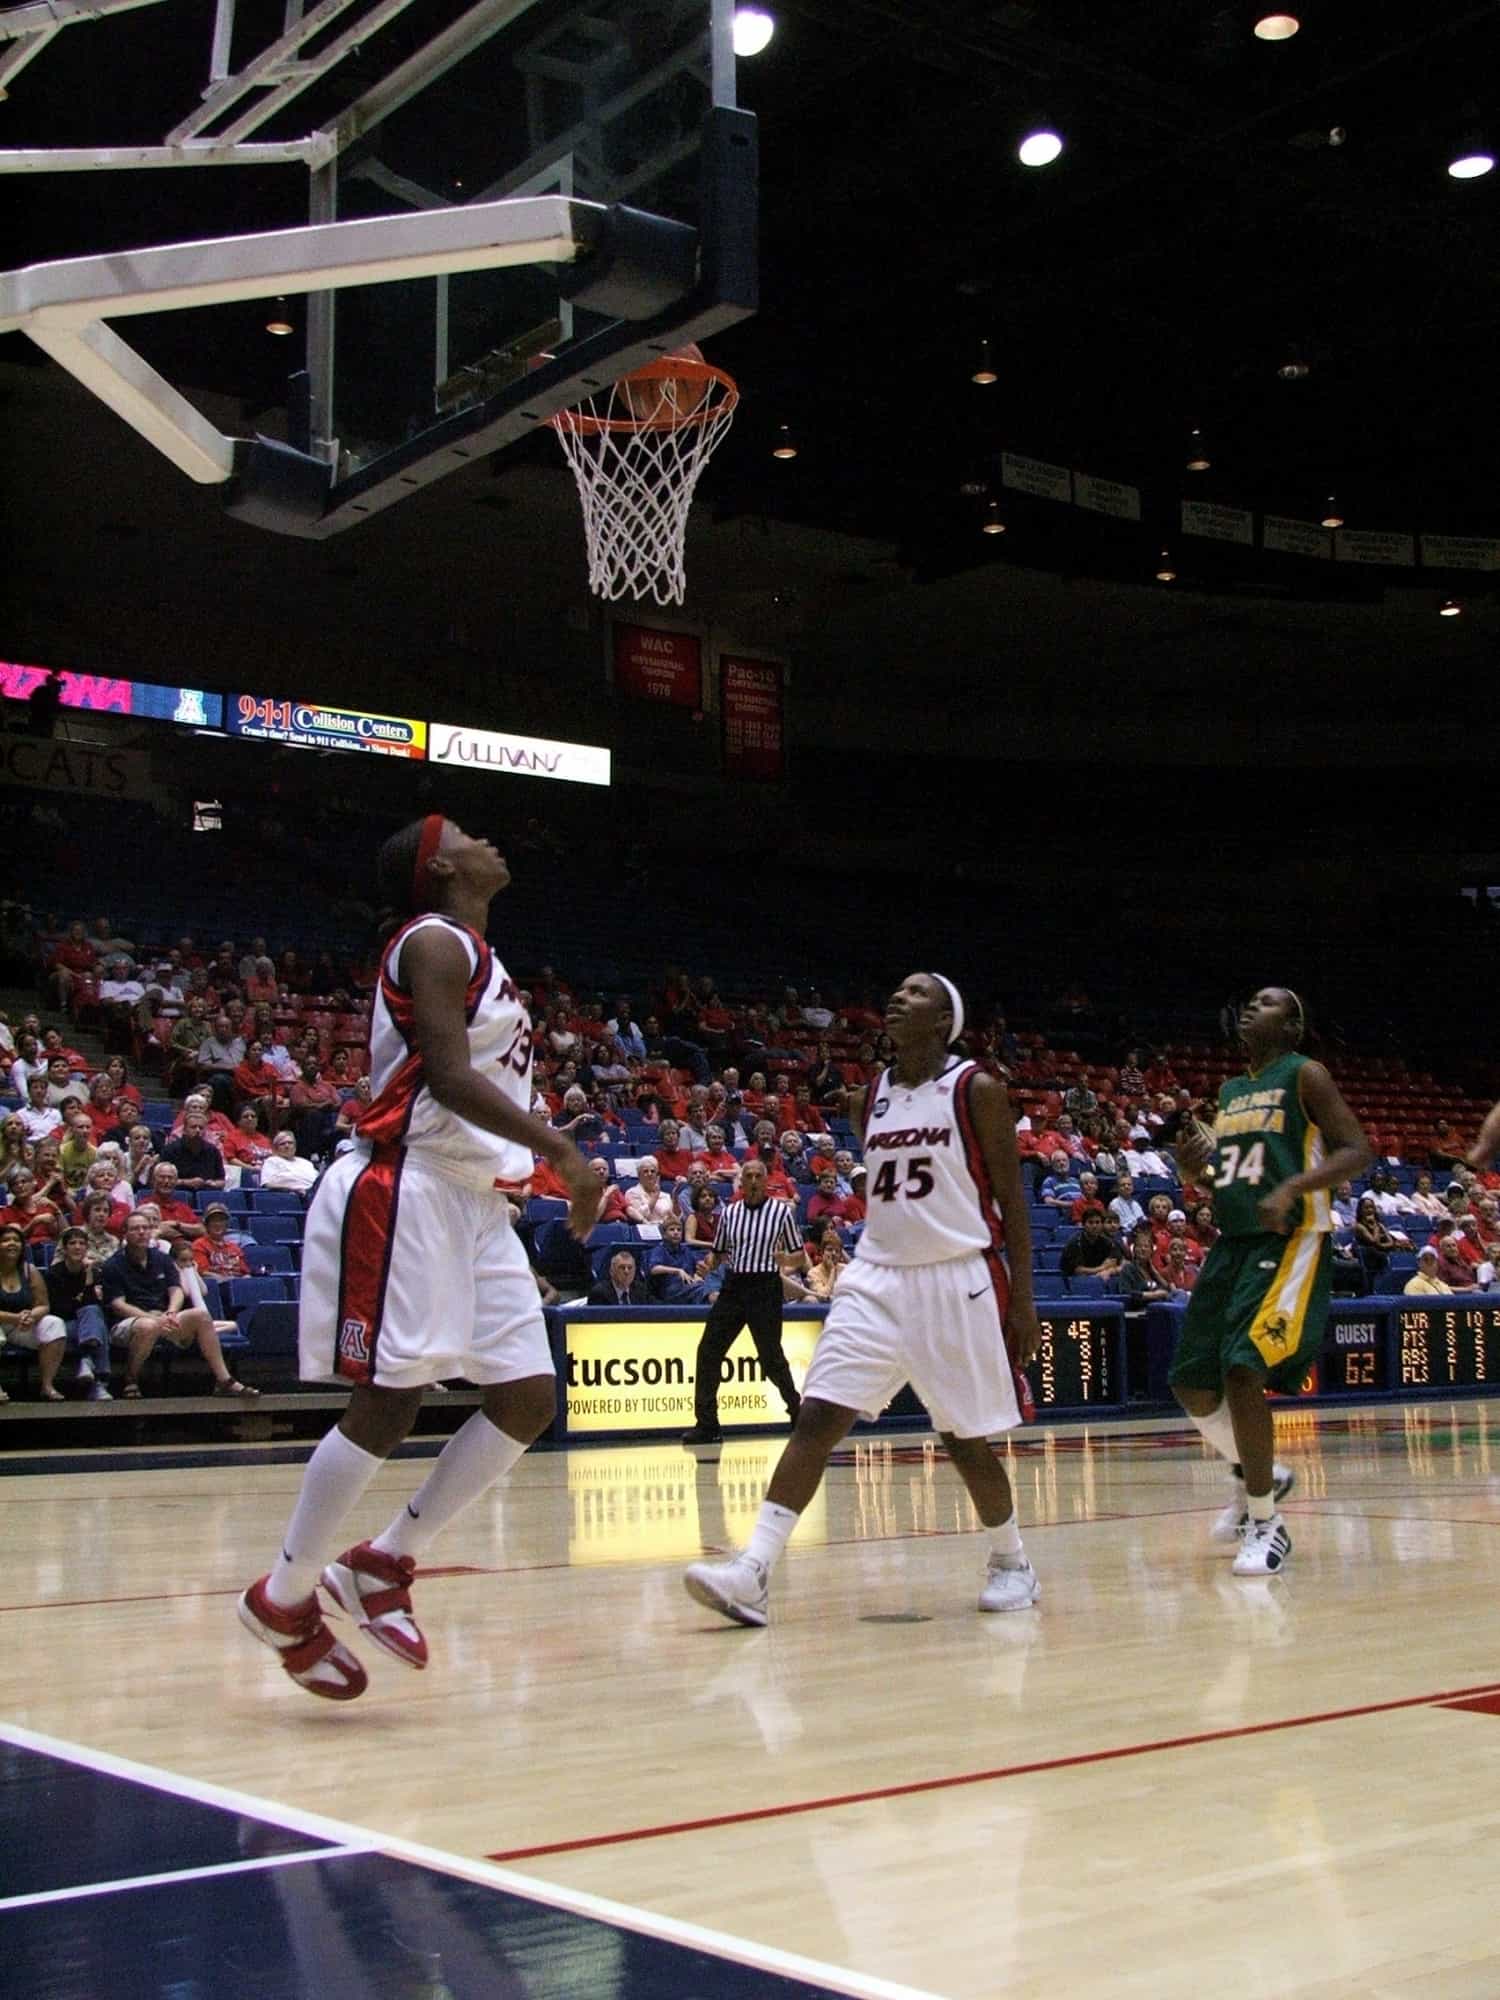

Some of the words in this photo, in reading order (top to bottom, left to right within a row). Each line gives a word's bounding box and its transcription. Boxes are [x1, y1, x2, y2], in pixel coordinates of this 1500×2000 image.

[297, 709, 356, 733] Collision
[357, 718, 409, 739] Centers
[437, 731, 563, 772] SULLIVANS
[866, 1127, 951, 1152] ARIZONA
[1214, 1142, 1265, 1188] 34
[872, 1157, 935, 1203] 45
[1067, 1320, 1091, 1339] 45
[1446, 1311, 1456, 1328] 5
[1466, 1311, 1483, 1328] 10
[1335, 1324, 1376, 1344] GUEST
[1403, 1330, 1426, 1347] PTS
[1080, 1341, 1091, 1359] 8
[567, 1351, 767, 1387] tucson.om
[1042, 1363, 1055, 1381] 2
[1080, 1361, 1092, 1380] 3
[1345, 1352, 1376, 1384] 62
[1403, 1366, 1430, 1384] FLS
[1042, 1383, 1055, 1402] 3
[567, 1399, 621, 1415] POWERED
[625, 1398, 639, 1413] BY
[642, 1396, 694, 1412] TUCSON'S
[717, 1394, 768, 1410] SPAPERS
